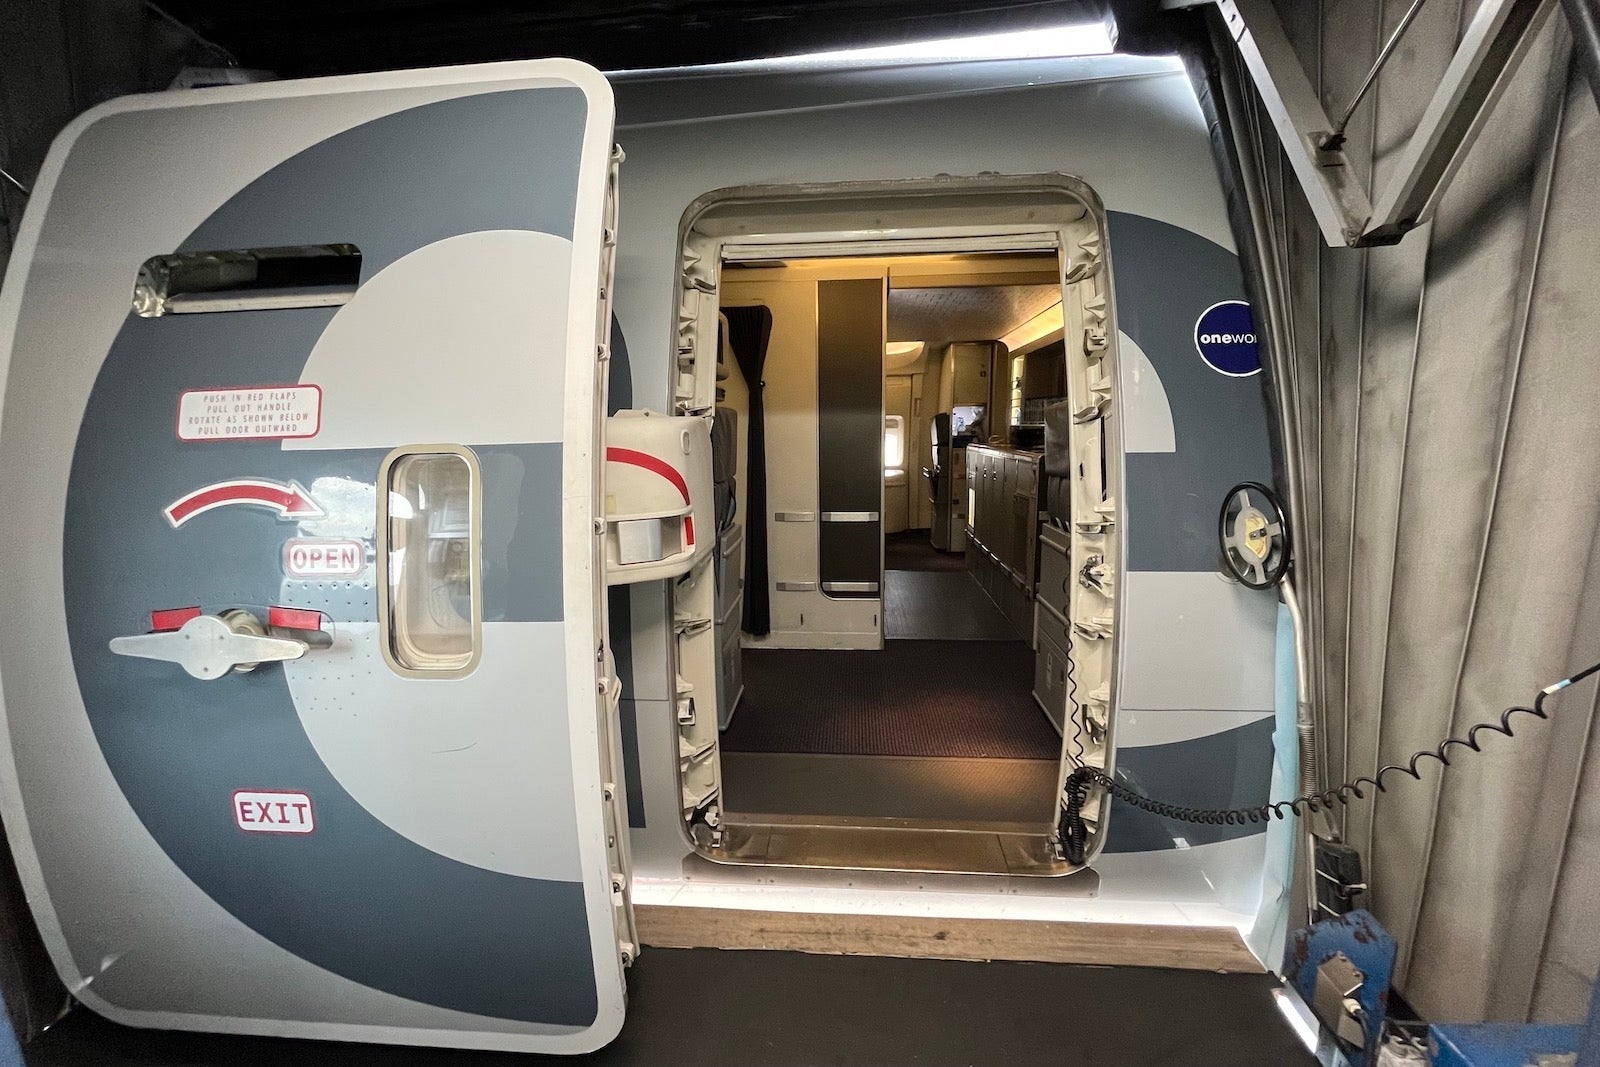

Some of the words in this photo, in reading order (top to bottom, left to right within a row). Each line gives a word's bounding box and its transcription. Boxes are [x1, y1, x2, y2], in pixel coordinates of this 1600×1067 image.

[204, 393, 226, 403] PUSH
[232, 393, 241, 402] IN
[248, 392, 264, 401] RED
[270, 391, 297, 400] FLAPS
[207, 405, 228, 413] PULL
[234, 404, 251, 412] OUT
[257, 402, 291, 412] HANDLE
[188, 415, 220, 425] ROTATE
[227, 415, 237, 423] AS
[243, 414, 273, 423] SHOWN
[279, 413, 309, 422] BELOW
[198, 426, 219, 435] PULL
[225, 425, 249, 434] DOOR
[255, 424, 298, 433] OUTWARD
[293, 548, 355, 568] OPEN
[239, 801, 307, 824] EXIT
